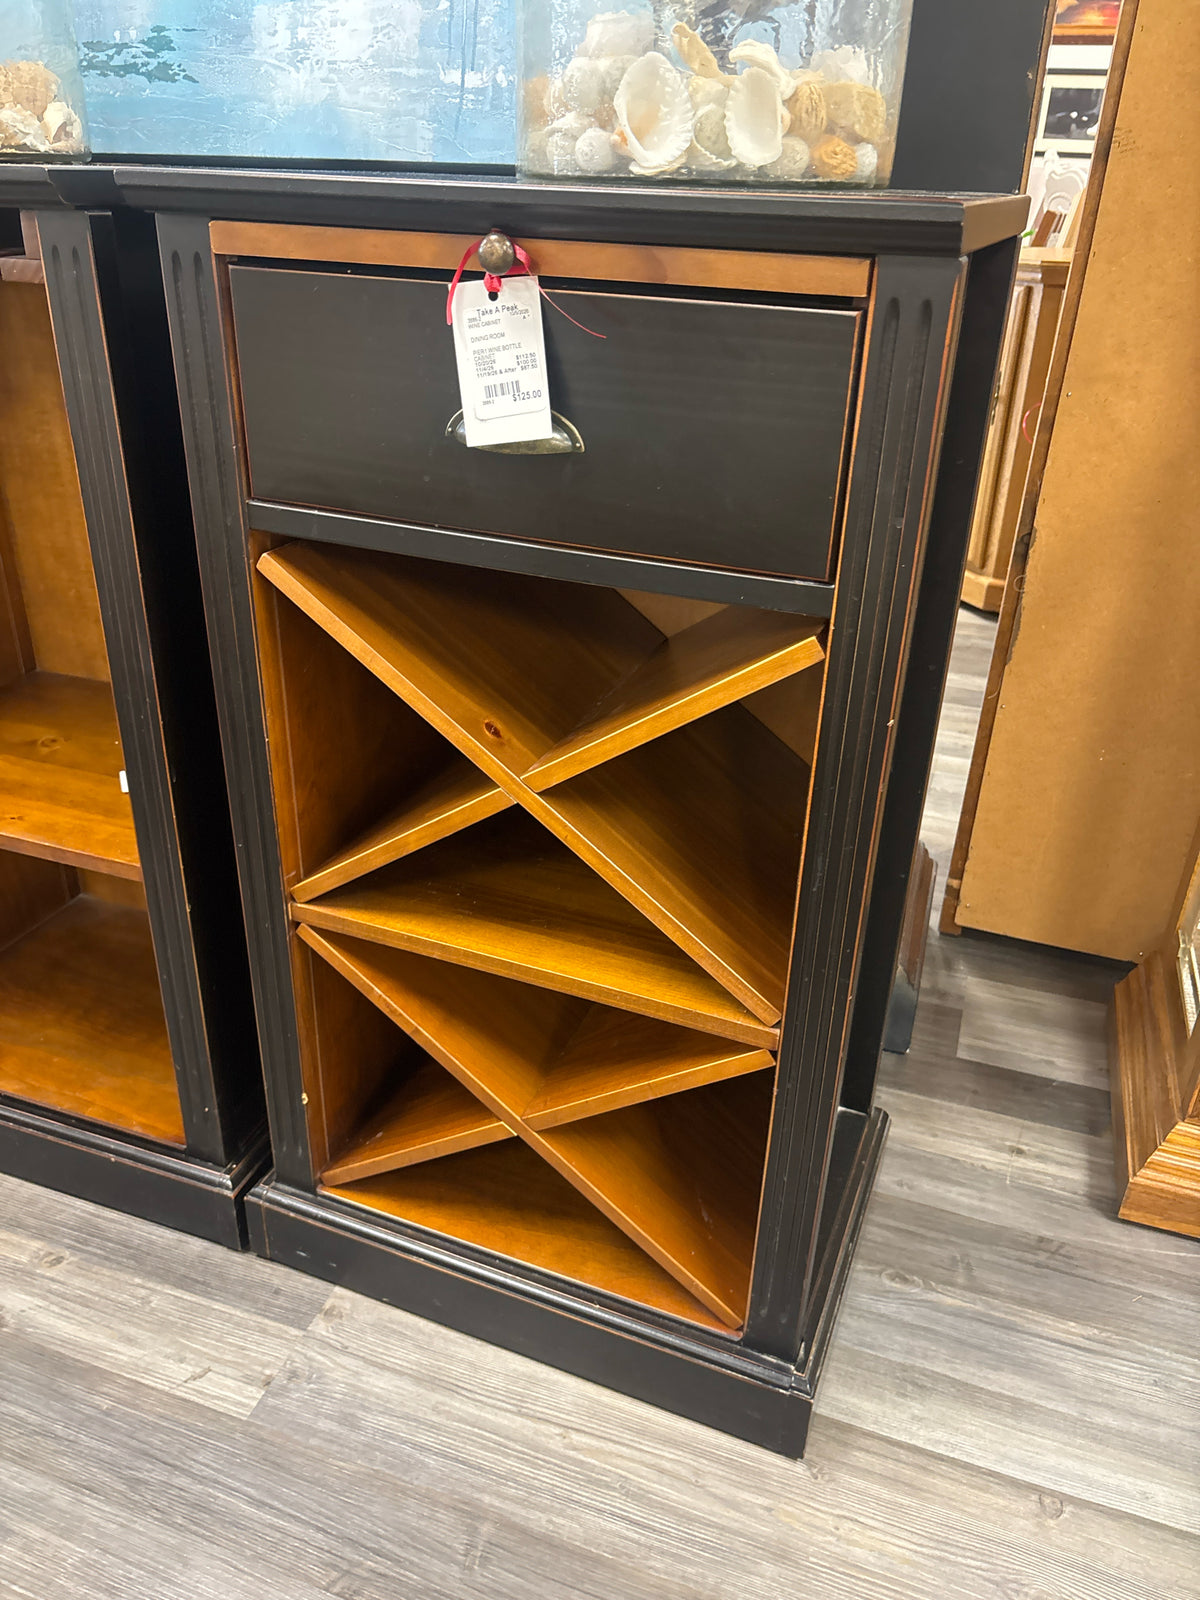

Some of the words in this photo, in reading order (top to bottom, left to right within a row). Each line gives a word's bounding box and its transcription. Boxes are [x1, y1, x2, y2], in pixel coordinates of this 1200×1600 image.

[476, 307, 493, 317] Take
[501, 304, 519, 312] Peak
[481, 319, 501, 327] CABINET
[471, 335, 489, 343] DINING
[487, 345, 501, 353] WINE
[502, 342, 522, 351] BOTTLE
[517, 358, 537, 366] $100.00
[512, 389, 542, 402] $125.00
